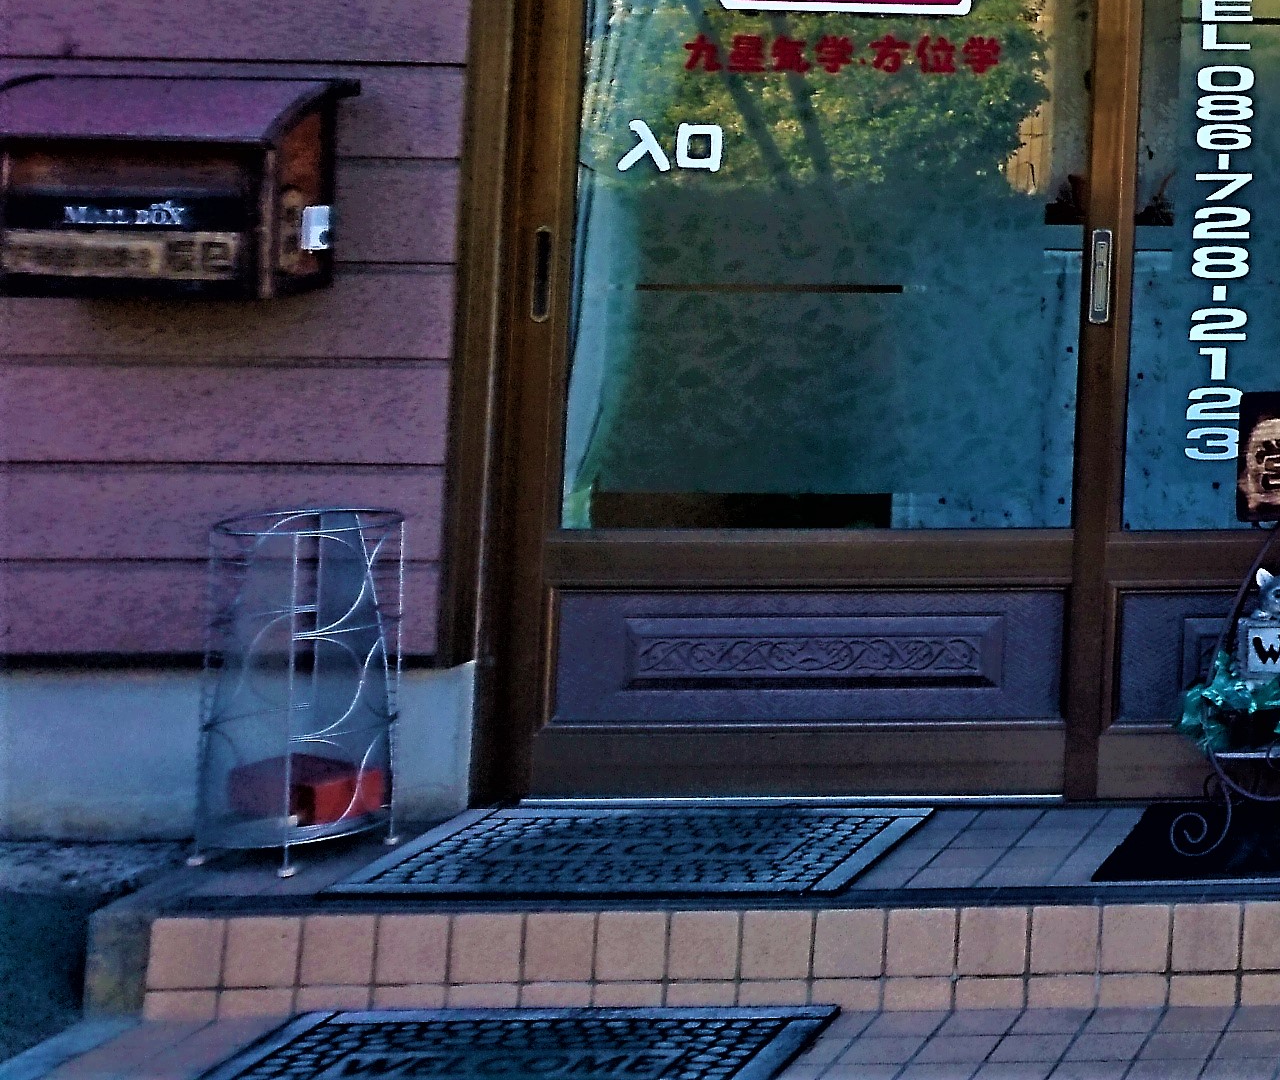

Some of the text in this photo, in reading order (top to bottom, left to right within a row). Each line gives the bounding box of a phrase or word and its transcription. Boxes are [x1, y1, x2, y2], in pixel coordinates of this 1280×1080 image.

[617, 119, 723, 172] 入口
[1184, 65, 1255, 461] 086-728-2123
[509, 841, 791, 856] WELCOME
[340, 1055, 669, 1077] WELCOME
